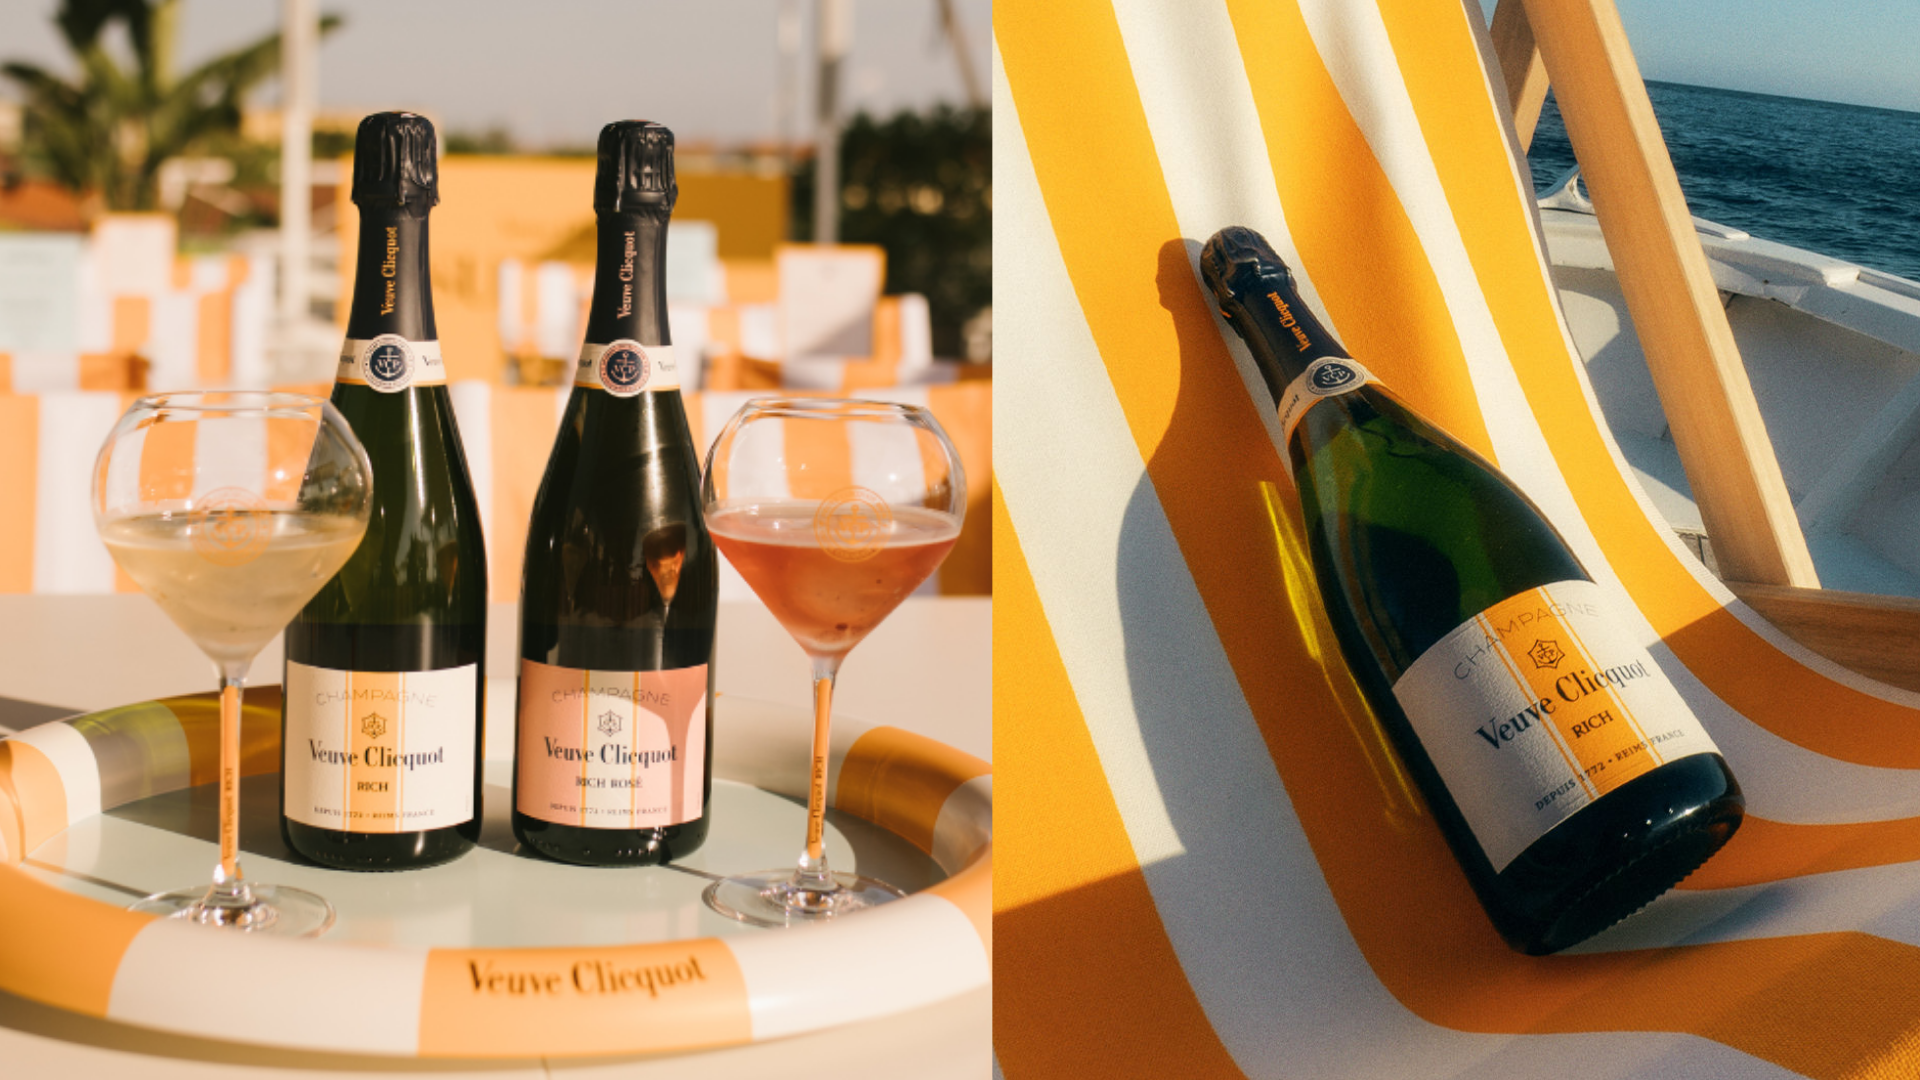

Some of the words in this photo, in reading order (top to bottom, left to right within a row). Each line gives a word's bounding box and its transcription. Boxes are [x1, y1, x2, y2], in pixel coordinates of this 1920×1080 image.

[380, 226, 400, 279] Clicquot
[618, 230, 638, 283] Clicquot
[381, 280, 397, 316] Veuve
[617, 284, 633, 319] Veuve
[1453, 602, 1600, 681] CHAMPAGNE
[315, 688, 438, 707] CHAMPAGNE
[551, 687, 672, 707] CHAMPAGNE
[1474, 696, 1557, 751] Veuve
[1554, 658, 1652, 704] Clicquot
[1571, 710, 1614, 739] RICH
[308, 738, 358, 767] Veuve
[364, 745, 444, 771] Clicquot
[543, 736, 595, 763] Veuve
[599, 743, 678, 768] Clicquot
[1534, 779, 1577, 811] DEPUIS
[1578, 760, 1607, 781] 1772
[1615, 740, 1649, 762] REIMS
[1650, 728, 1686, 745] FRANCE
[357, 780, 389, 793] RICH
[575, 776, 606, 788] RICH
[610, 776, 643, 788] ROSÉ
[467, 958, 562, 995] Veuve
[570, 954, 706, 1000] Clicquot
